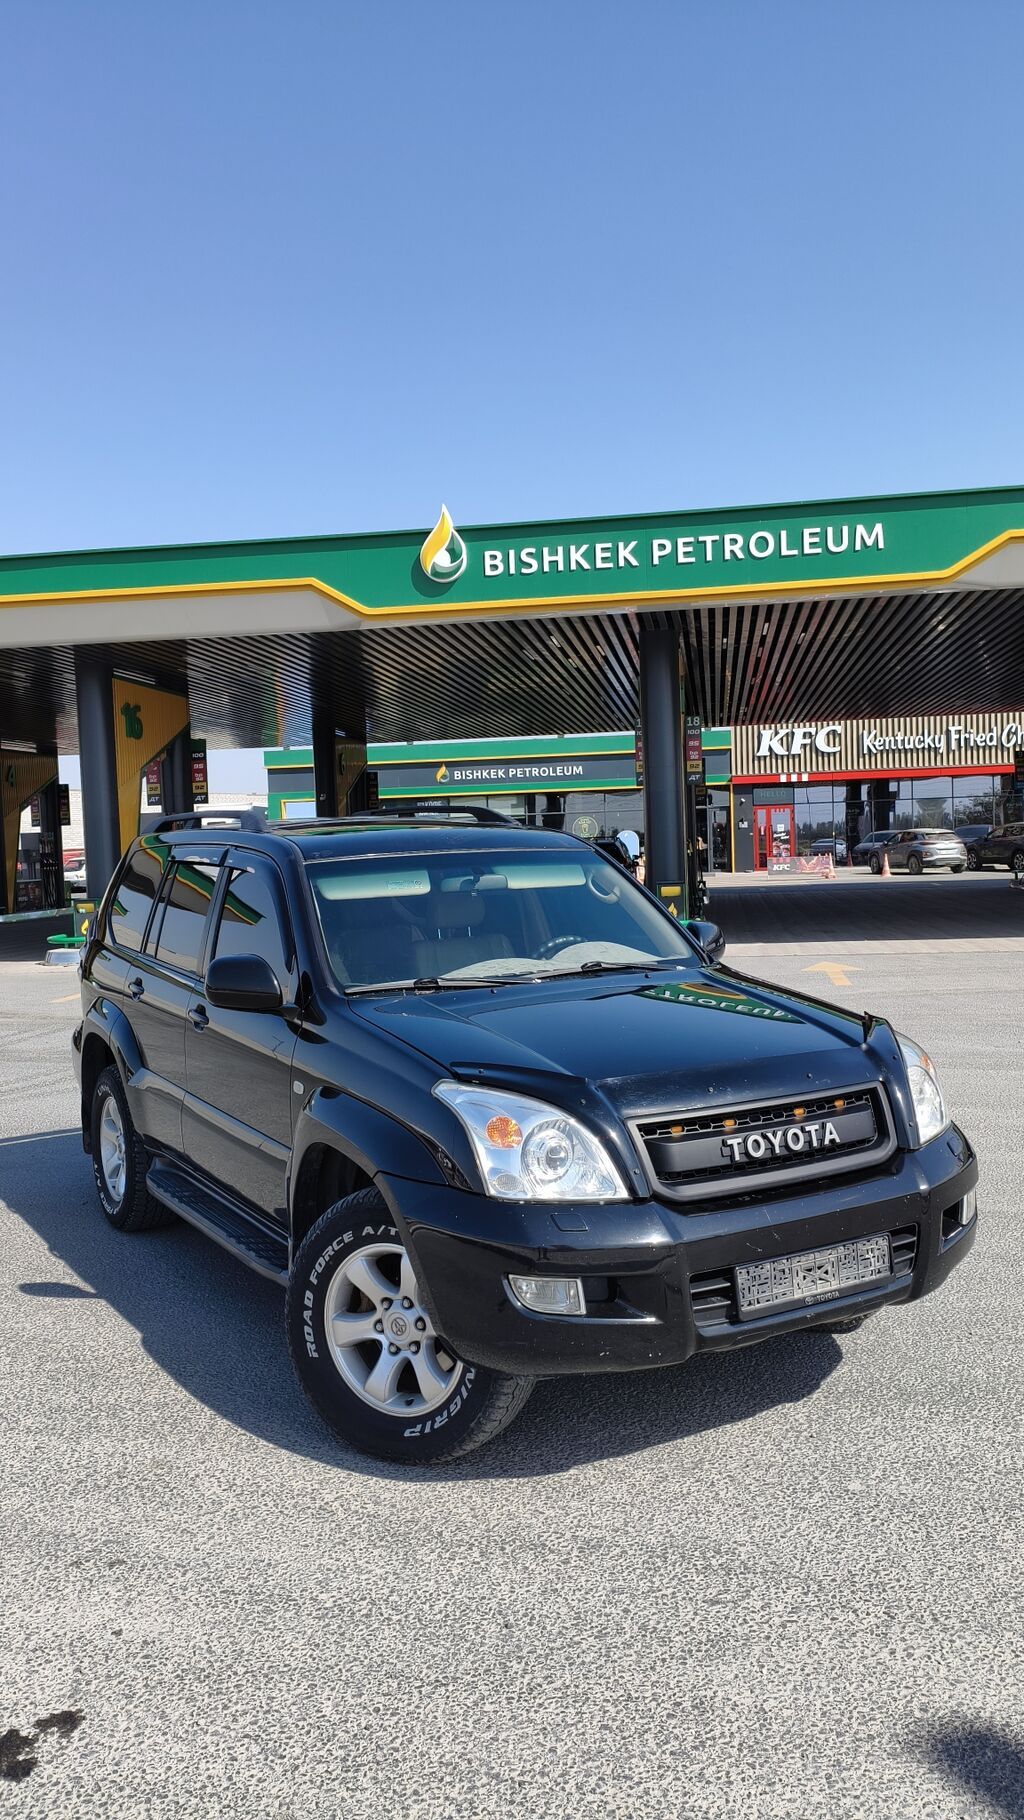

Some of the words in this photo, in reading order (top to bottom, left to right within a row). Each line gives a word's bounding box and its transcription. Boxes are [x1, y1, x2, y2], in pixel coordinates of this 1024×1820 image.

[483, 540, 639, 577] BISHKEK
[652, 523, 885, 565] PETROLEUM
[120, 702, 143, 740] 16
[686, 716, 700, 727] 18
[756, 725, 842, 757] KFC
[863, 729, 944, 754] Kentucky
[948, 725, 997, 751] Fried
[453, 769, 506, 780] BISHKEK
[508, 765, 583, 778] PETROLEUM
[726, 1122, 840, 1161] TOYOTA
[361, 1224, 399, 1237] A/T
[309, 1230, 354, 1285] FORCE
[816, 1290, 840, 1302] TOYOTA
[303, 1289, 319, 1358] ROAD
[403, 1367, 475, 1437] NIGRIP
